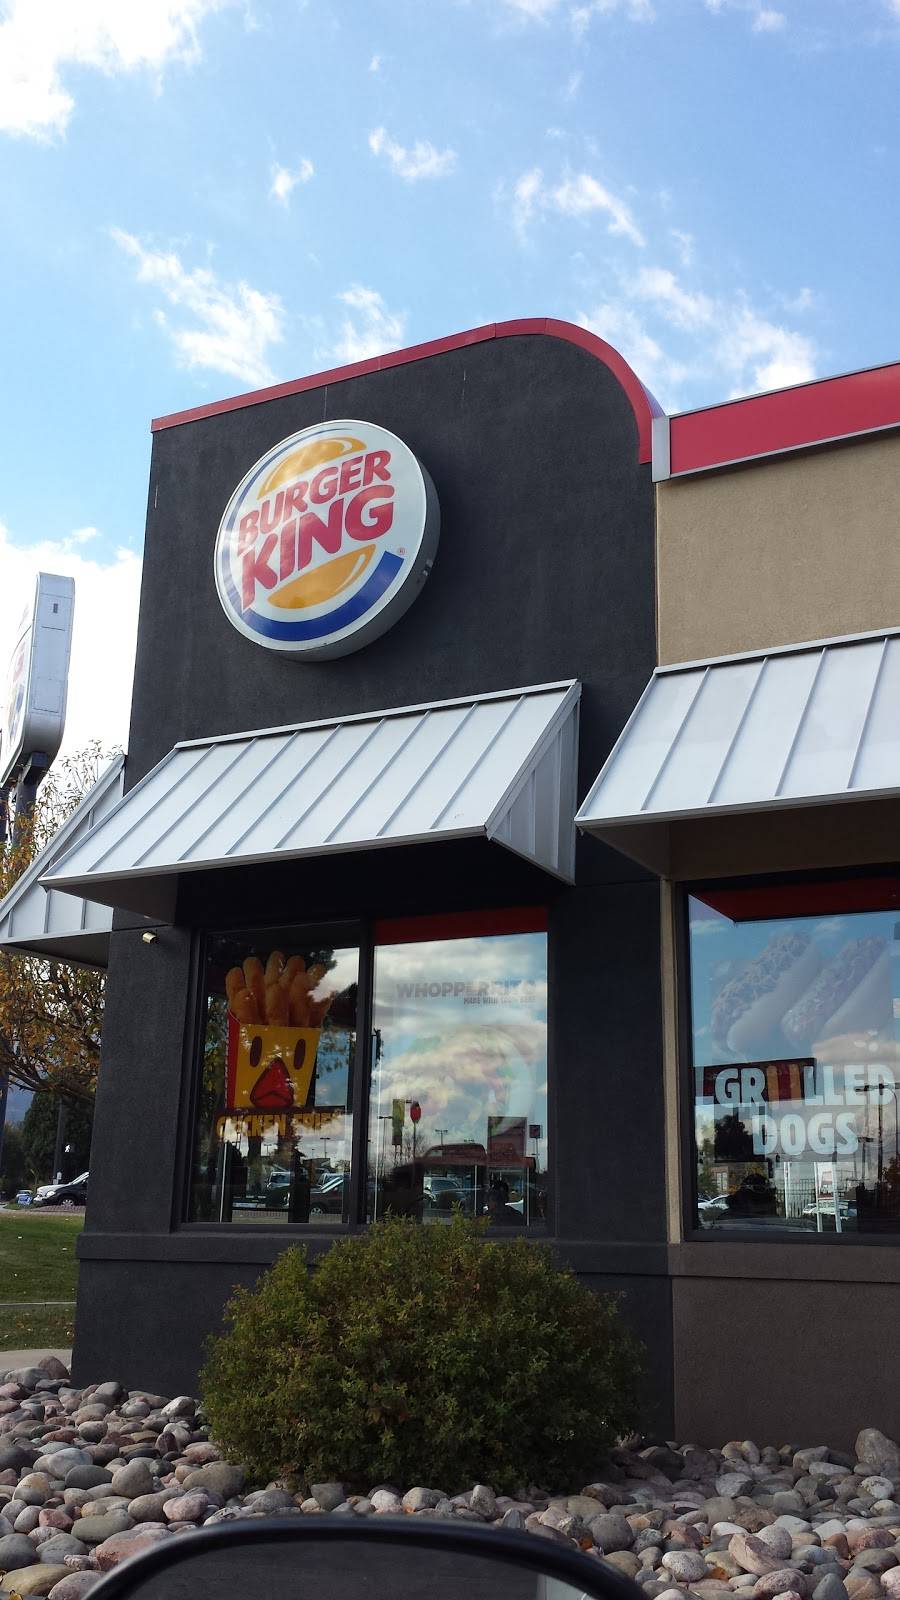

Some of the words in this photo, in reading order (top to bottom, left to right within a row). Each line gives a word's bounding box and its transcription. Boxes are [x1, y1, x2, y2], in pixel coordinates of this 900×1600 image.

[237, 450, 391, 553] BURGER
[242, 485, 395, 611] KING
[752, 1112, 859, 1156] DOGS
